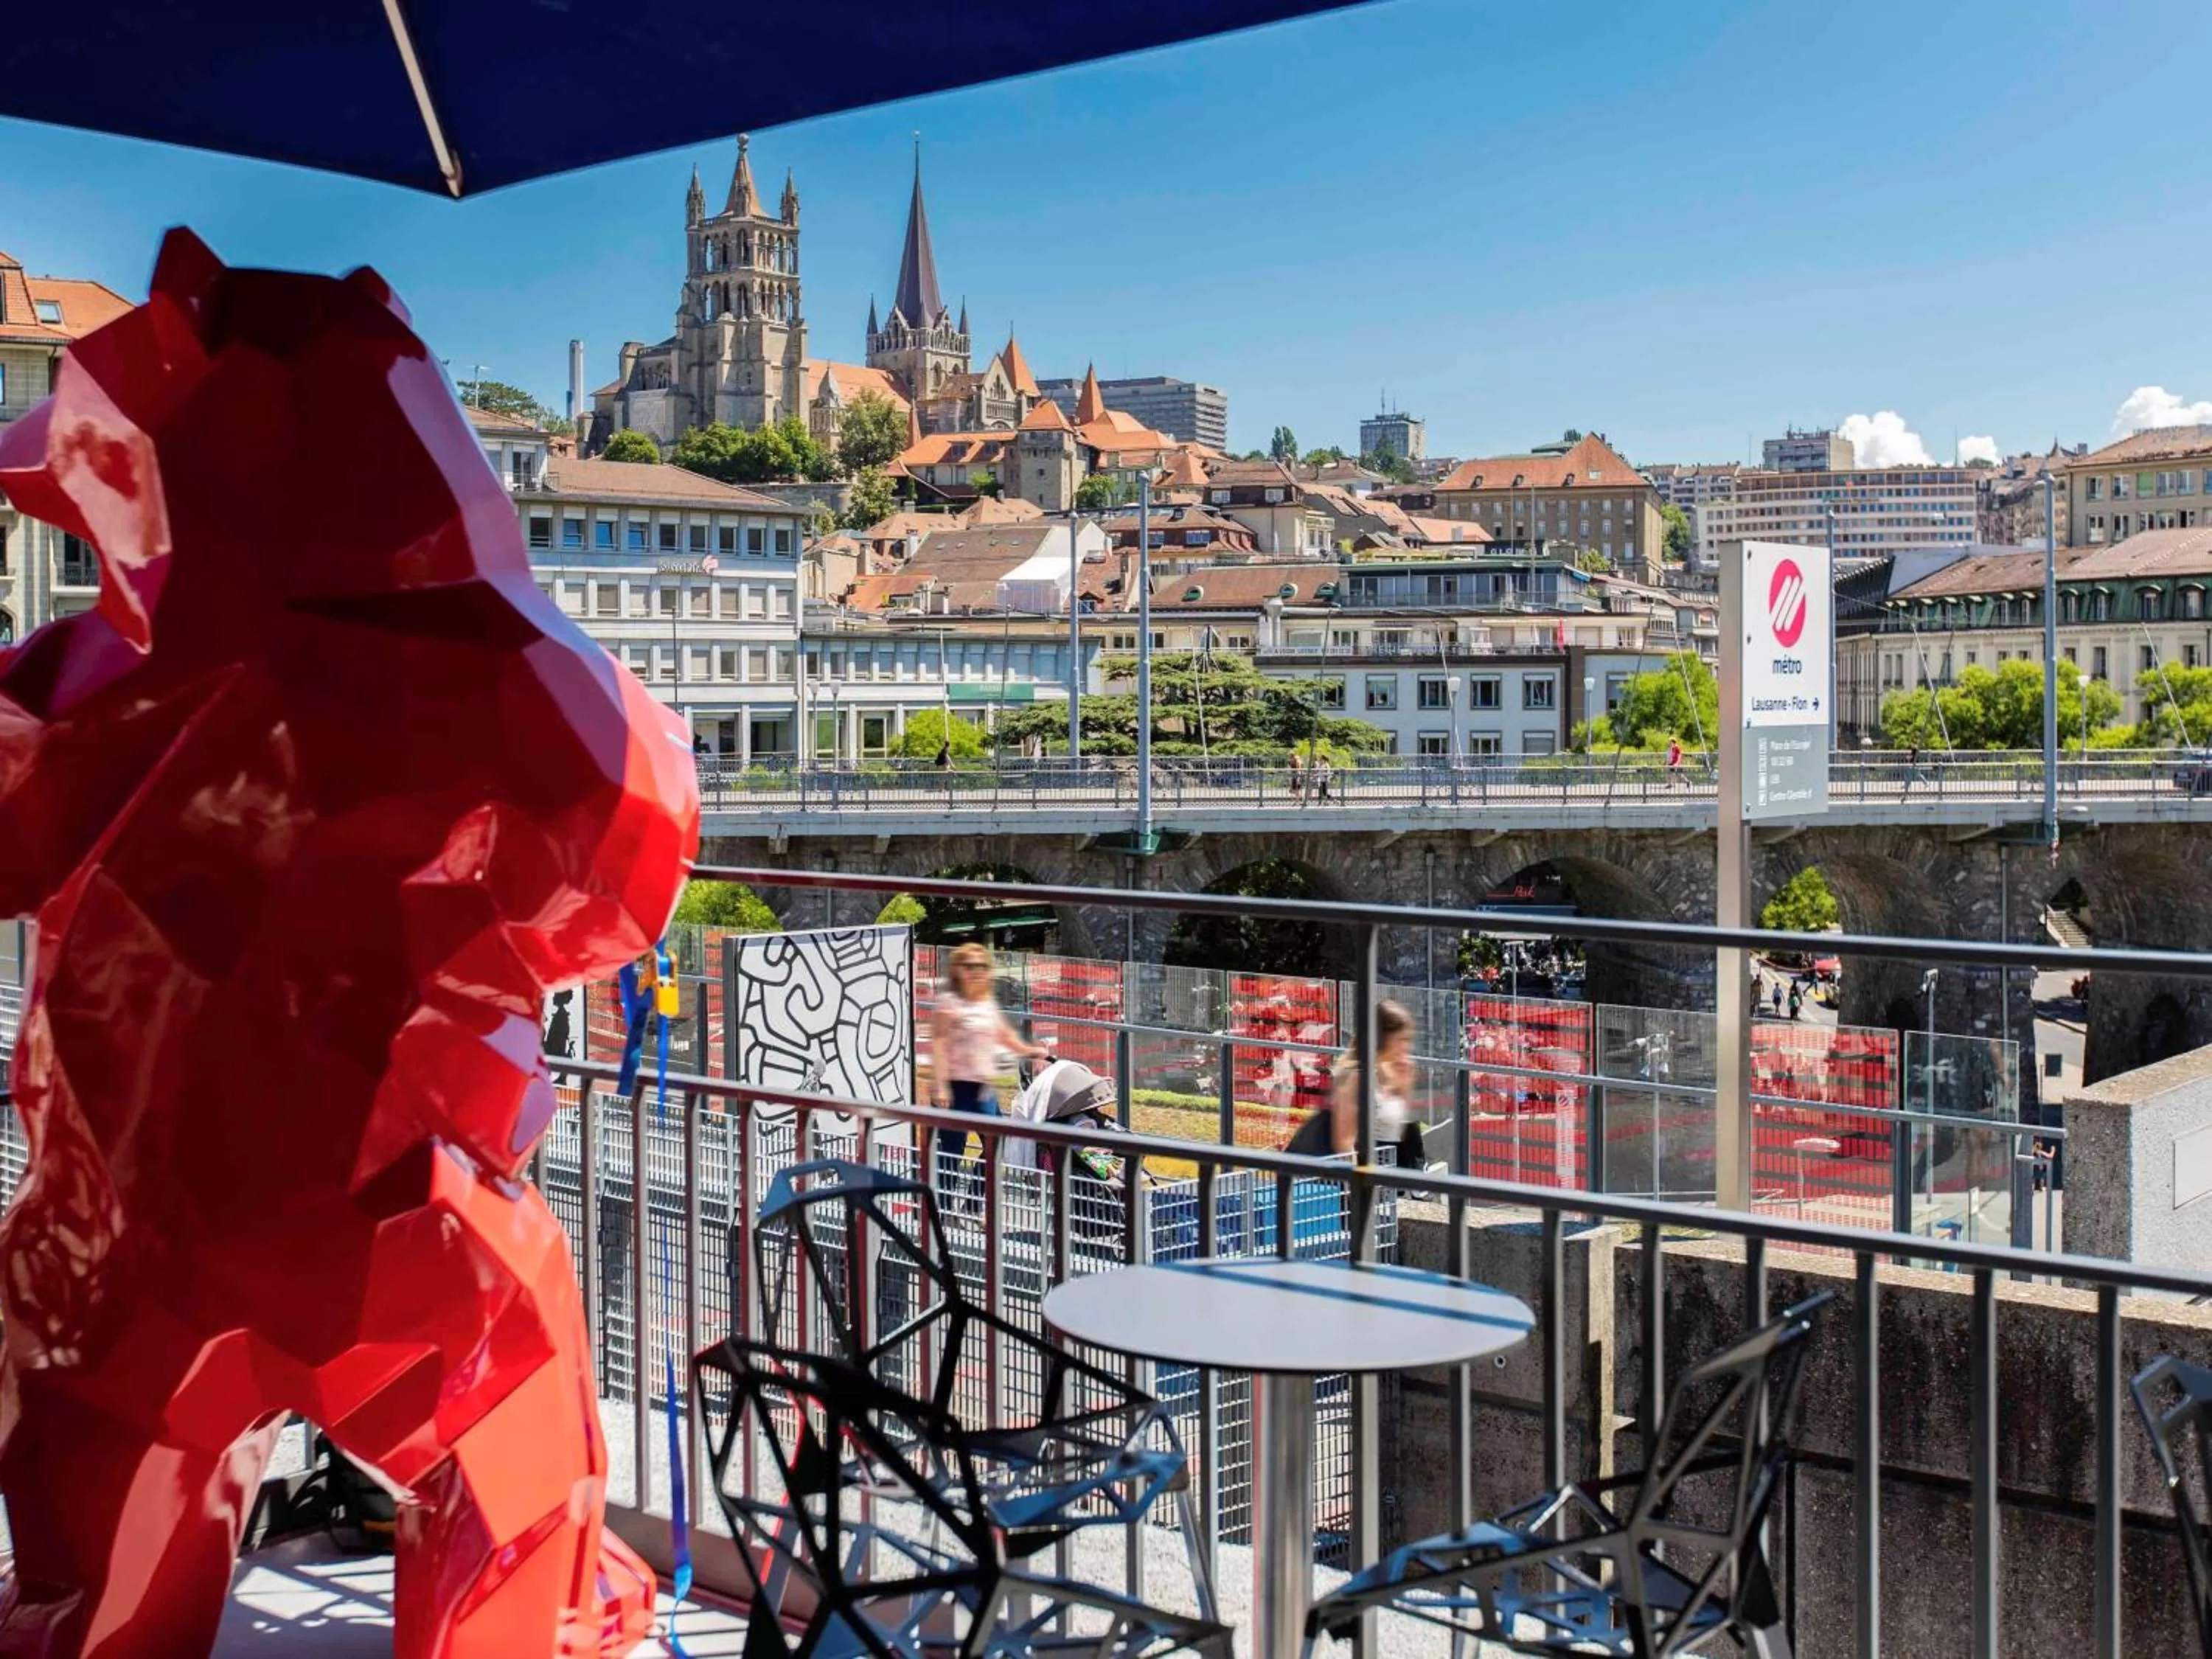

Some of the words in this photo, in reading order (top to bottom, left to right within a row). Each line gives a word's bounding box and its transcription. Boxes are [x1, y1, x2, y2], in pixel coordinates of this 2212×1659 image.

[1773, 654, 1802, 674] métro
[1752, 697, 1787, 711] Lausanne
[1792, 696, 1807, 710] Flon
